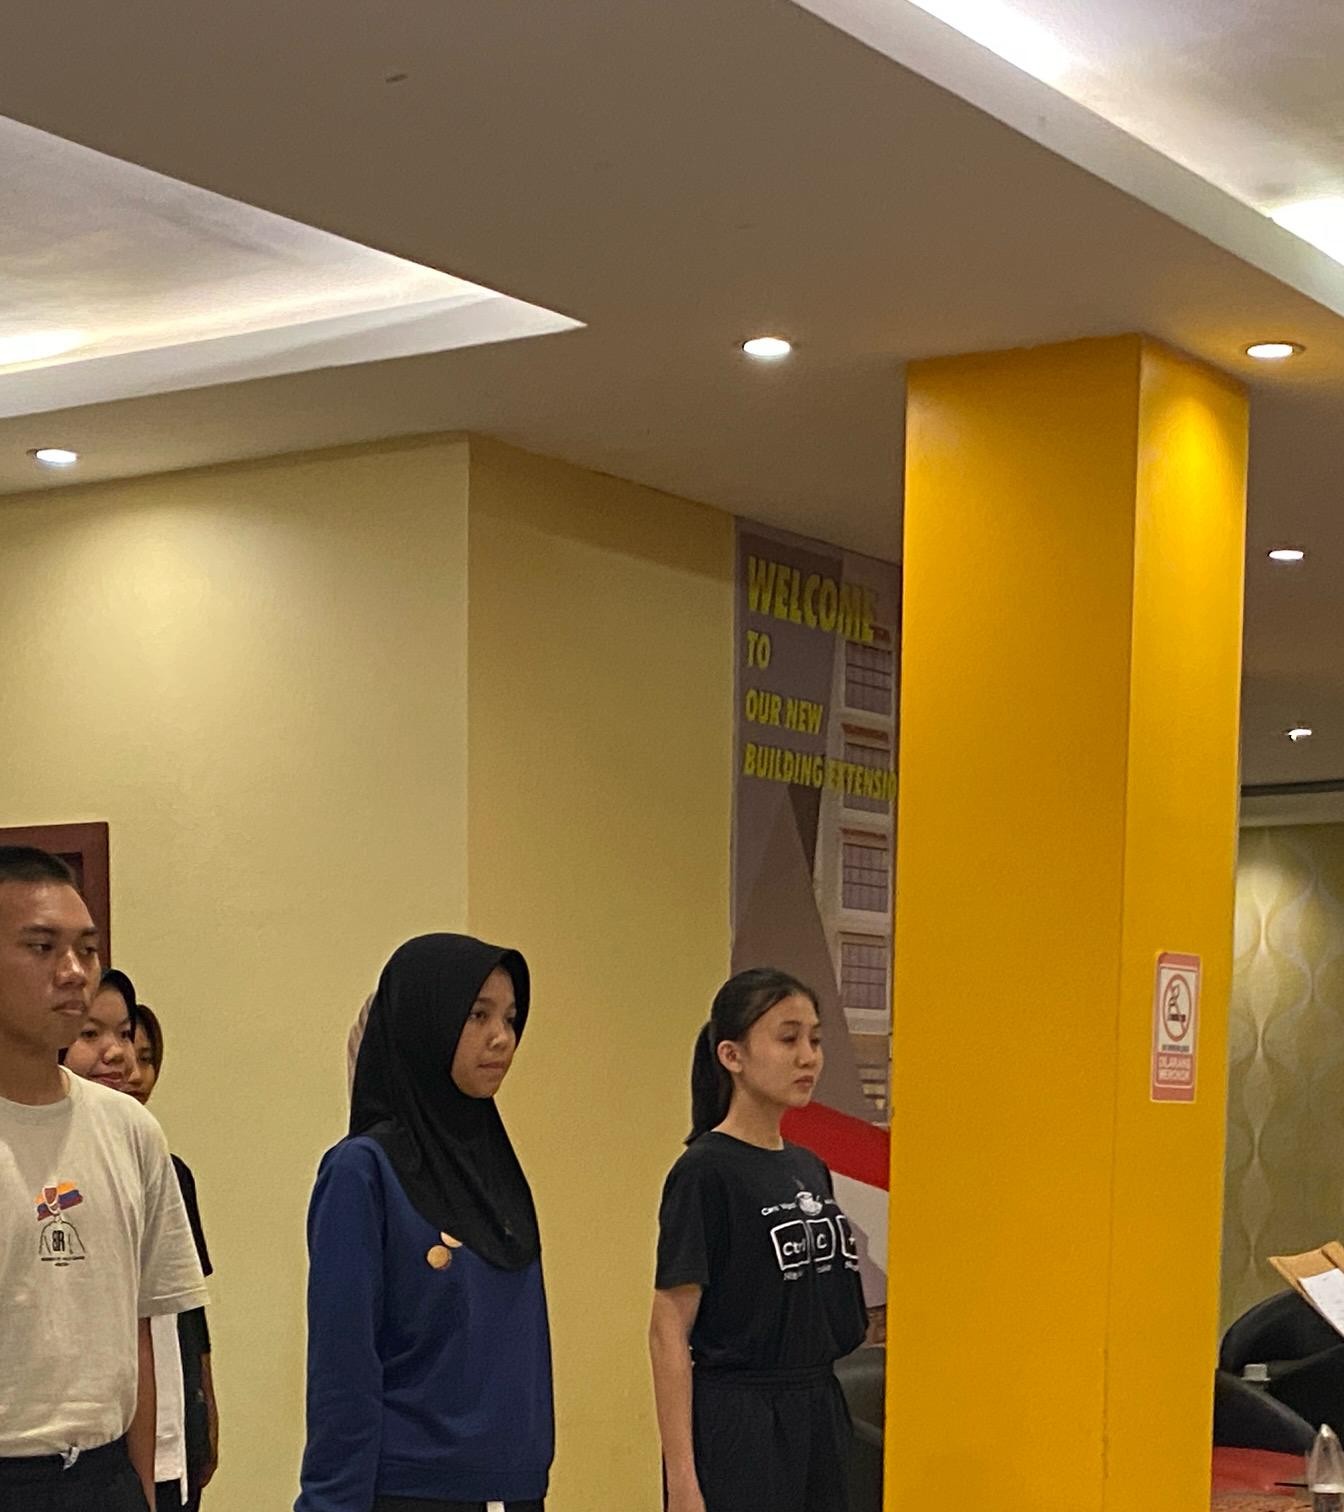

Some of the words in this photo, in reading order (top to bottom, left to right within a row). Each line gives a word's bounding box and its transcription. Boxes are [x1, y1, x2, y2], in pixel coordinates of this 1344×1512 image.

[747, 555, 877, 643] WELCOME
[746, 630, 771, 670] TO
[745, 688, 782, 726] OUR
[785, 697, 824, 735] NEW
[743, 743, 825, 788] BUILDING
[782, 1237, 806, 1256] Ctrl
[816, 1233, 828, 1249] C
